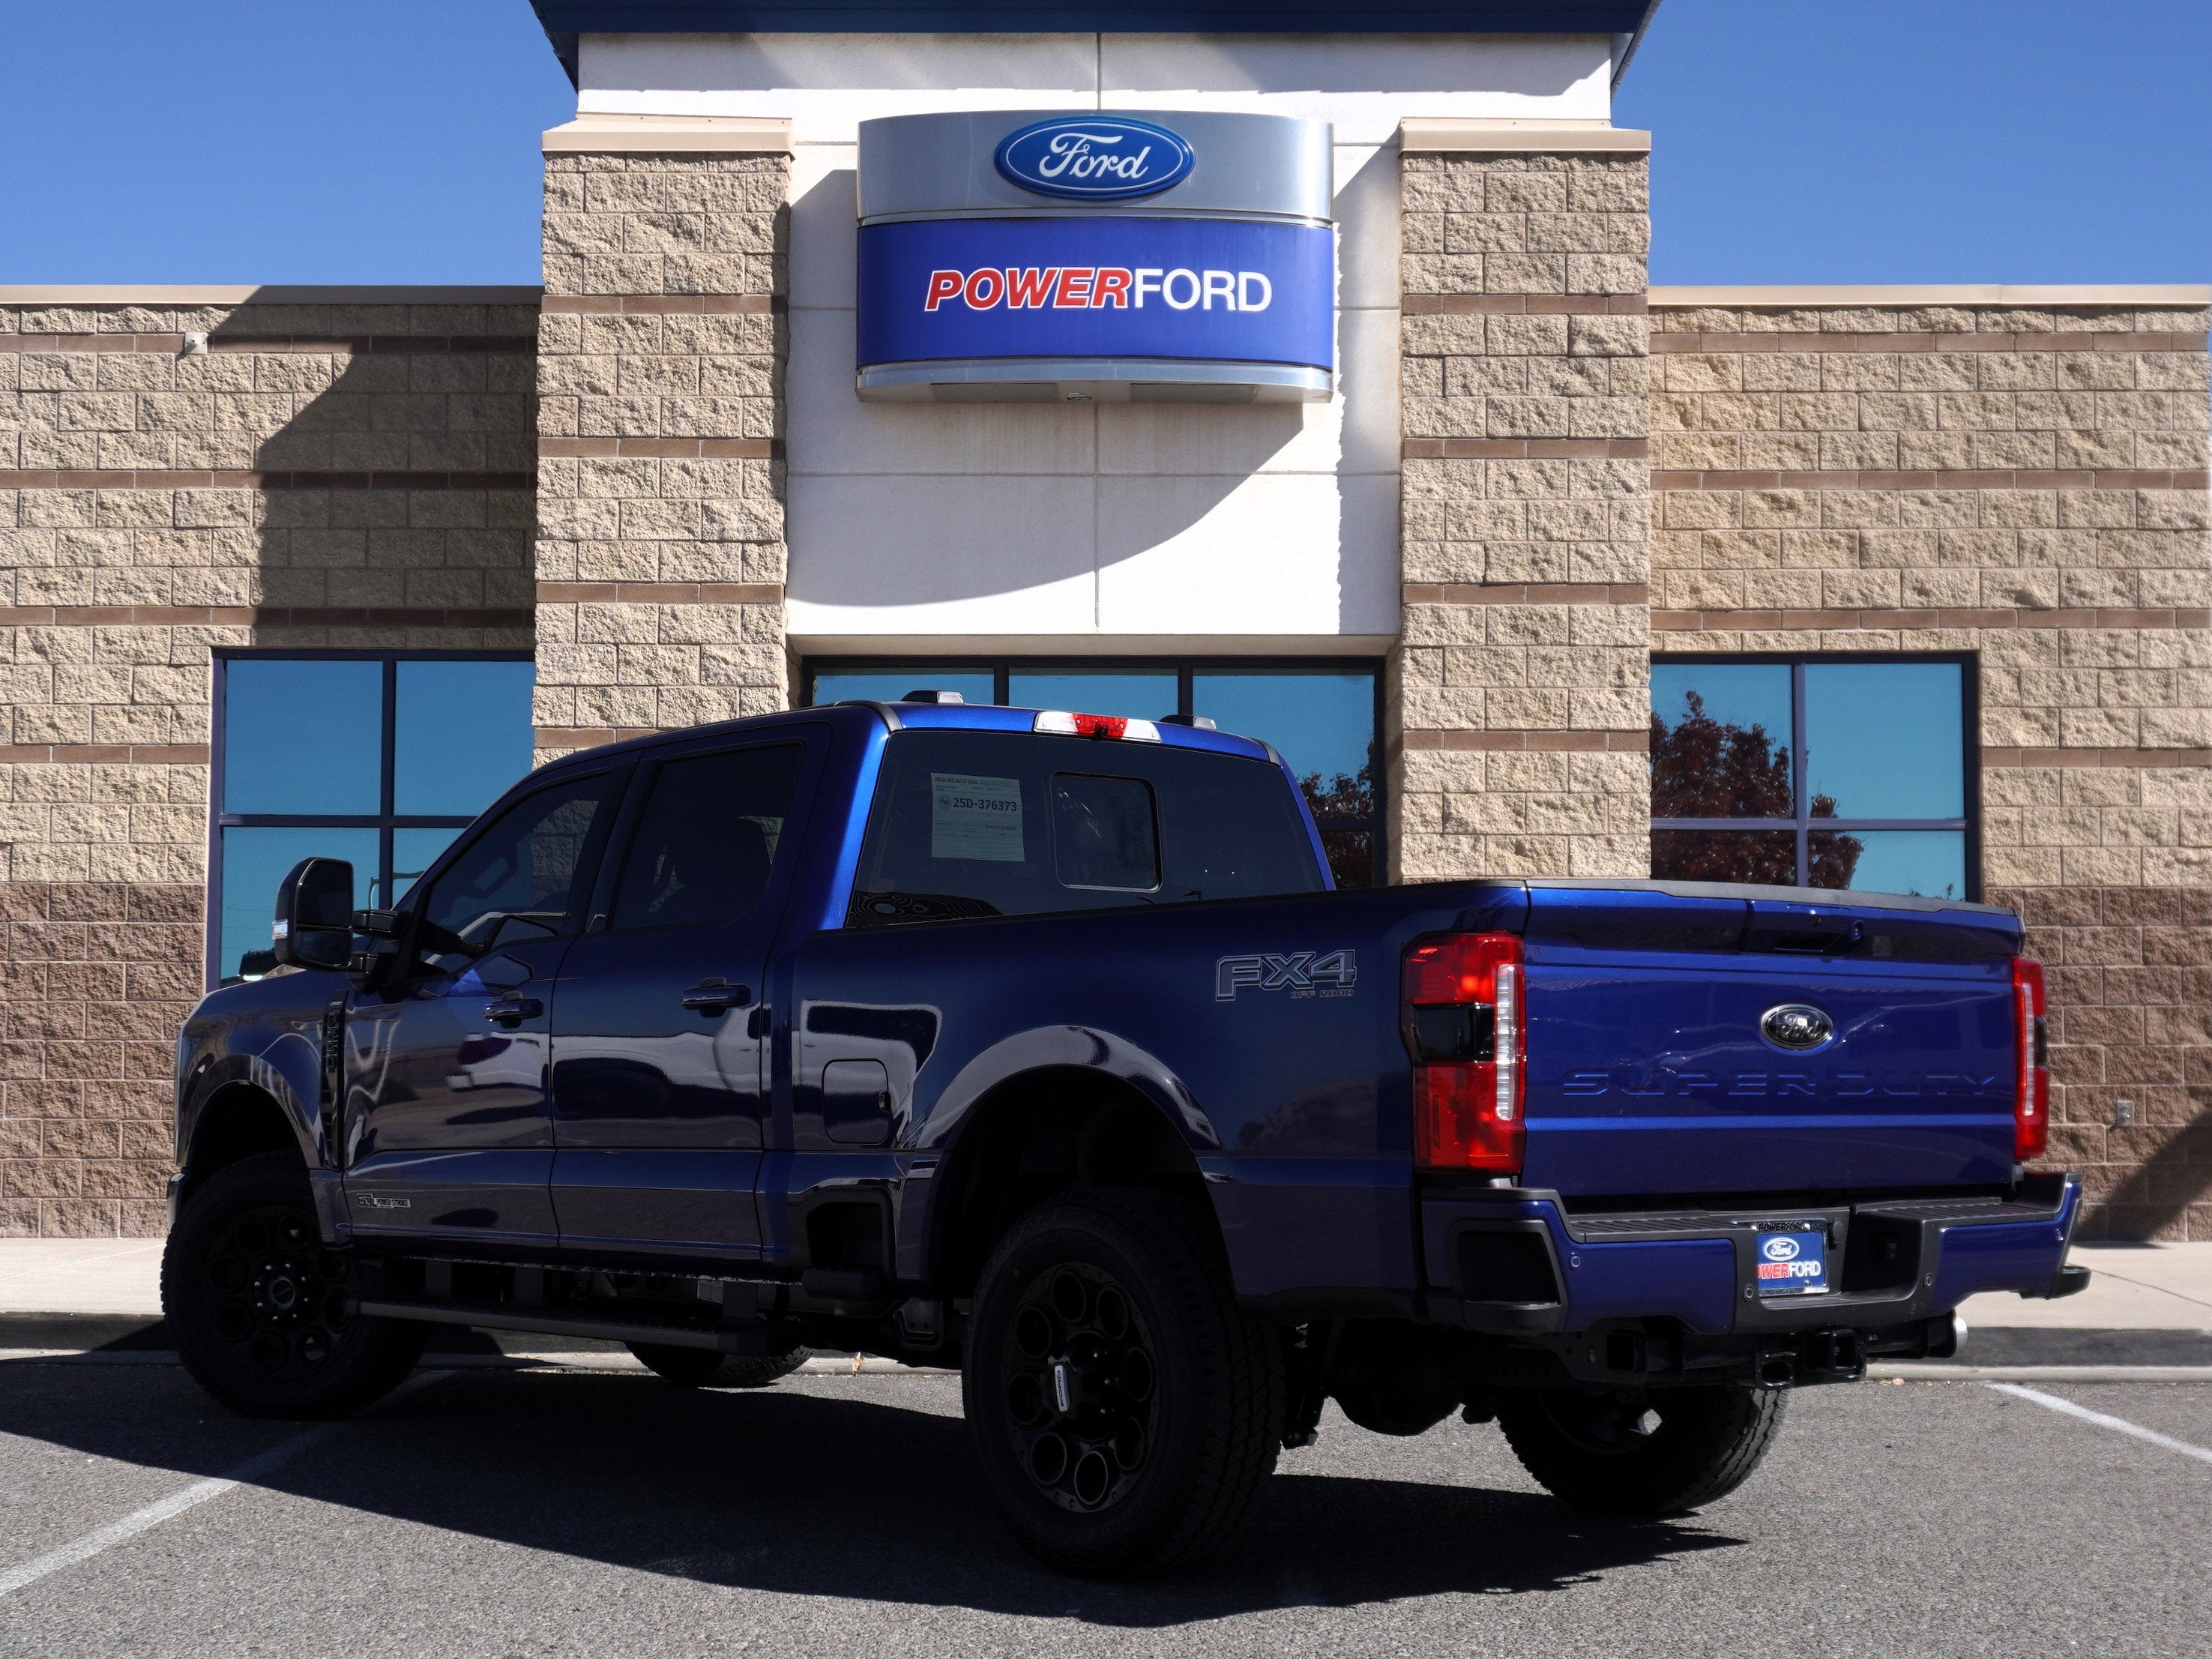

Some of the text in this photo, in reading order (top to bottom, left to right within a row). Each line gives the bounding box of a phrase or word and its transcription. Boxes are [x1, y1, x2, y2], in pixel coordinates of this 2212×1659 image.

[1039, 132, 1152, 179] Ford
[924, 267, 1273, 313] POWERFORD
[953, 797, 1017, 811] 25D-376373
[1215, 948, 1357, 1002] FX4
[1290, 989, 1355, 999] OFF ROAD
[1779, 1013, 1821, 1039] Ford
[1562, 1071, 1998, 1096] SUPER DUTY
[1770, 1241, 1792, 1256] Ford
